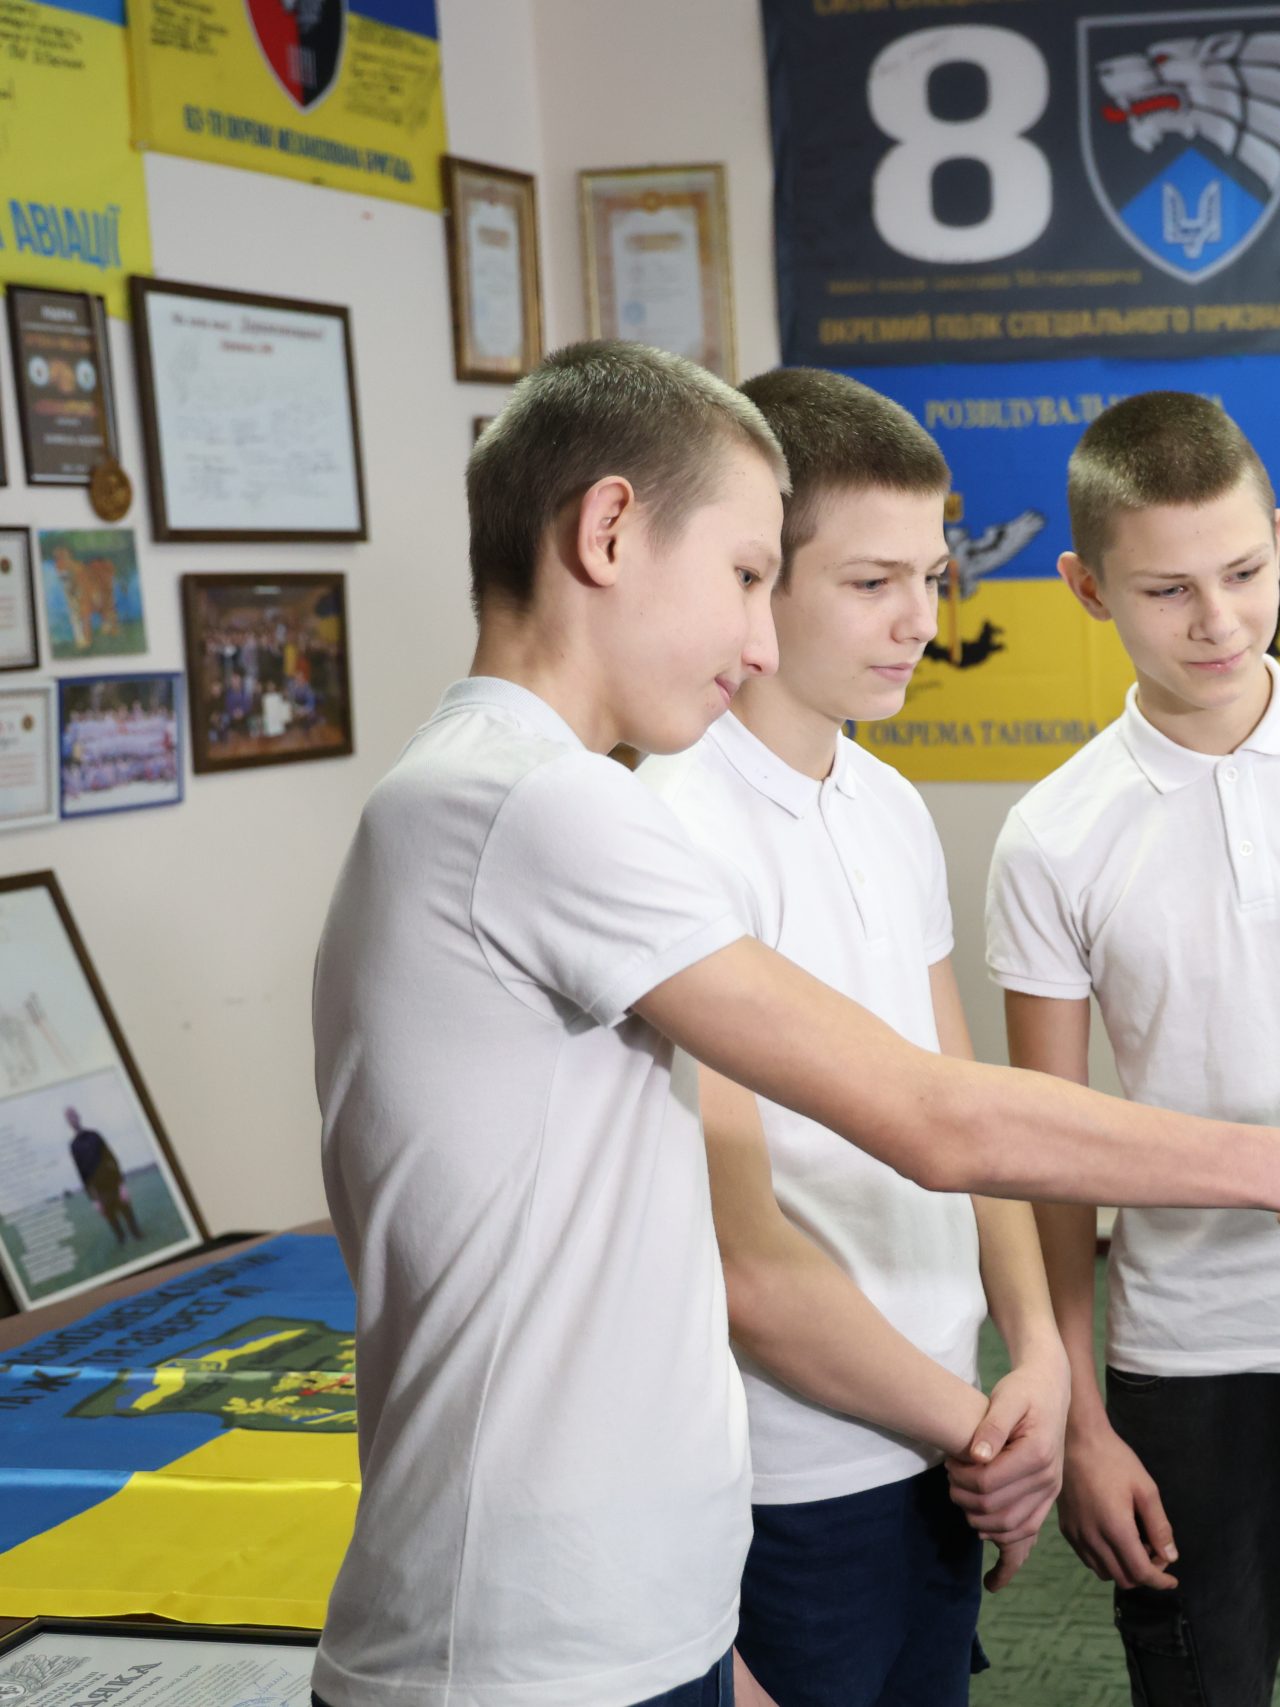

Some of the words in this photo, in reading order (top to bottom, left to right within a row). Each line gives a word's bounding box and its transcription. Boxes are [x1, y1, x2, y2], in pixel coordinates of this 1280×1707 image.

[868, 22, 1054, 265] 8
[8, 198, 122, 272] АВІАЦІЇ
[926, 393, 1116, 430] РОЗВІДУВАЛ
[868, 719, 976, 748] ОКРЕМА
